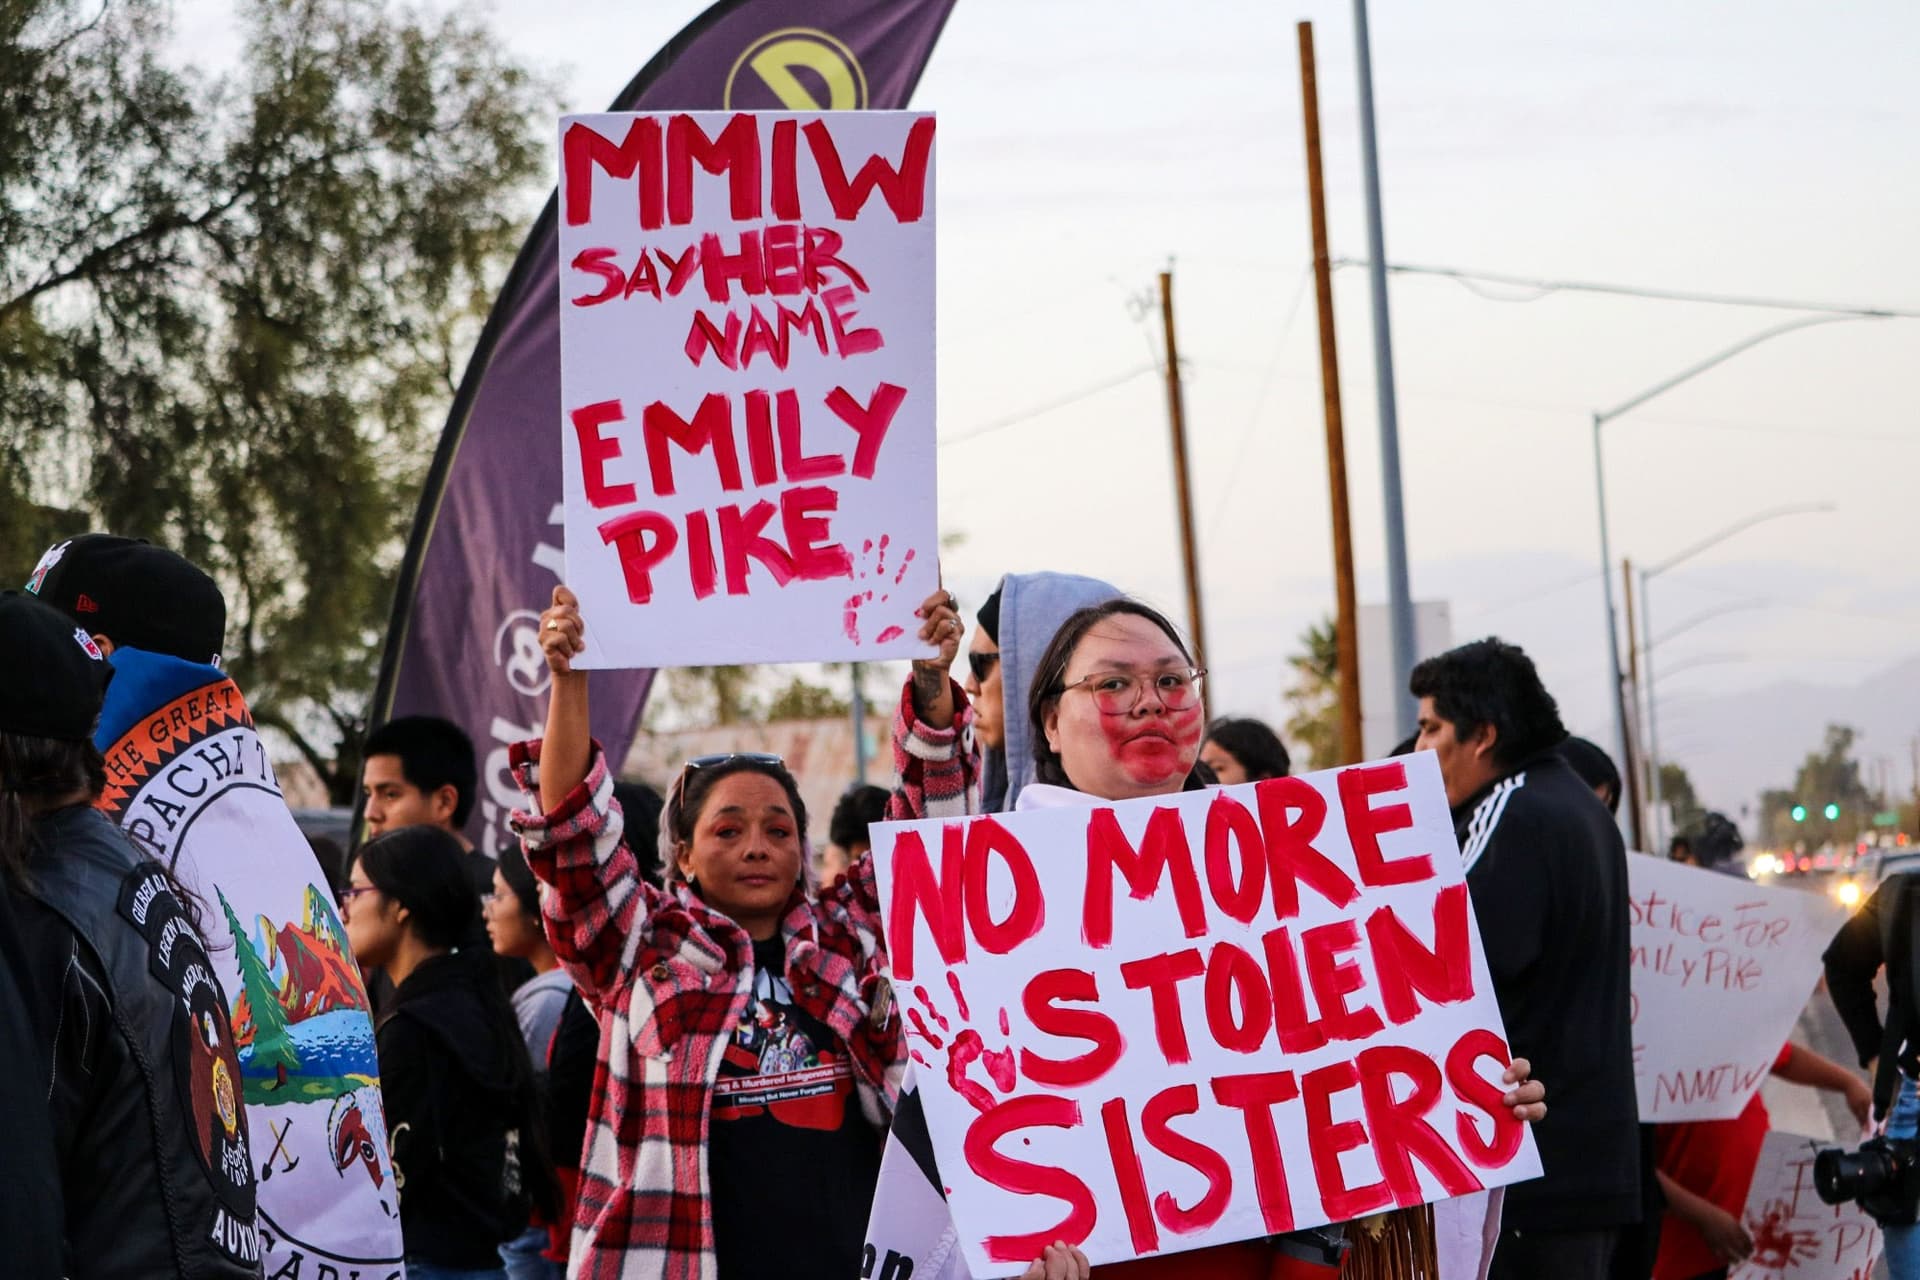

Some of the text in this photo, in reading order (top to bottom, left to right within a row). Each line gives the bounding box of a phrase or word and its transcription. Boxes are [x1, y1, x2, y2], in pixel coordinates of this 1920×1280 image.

[563, 113, 937, 231] MMIW
[685, 285, 885, 371] NAME
[570, 382, 907, 509] EMILY
[597, 486, 854, 605] PIKE
[148, 686, 235, 743] GREAT
[887, 762, 1438, 981] NO MORE
[1020, 882, 1475, 1089] STOLEN
[964, 1029, 1525, 1262] SISTERS
